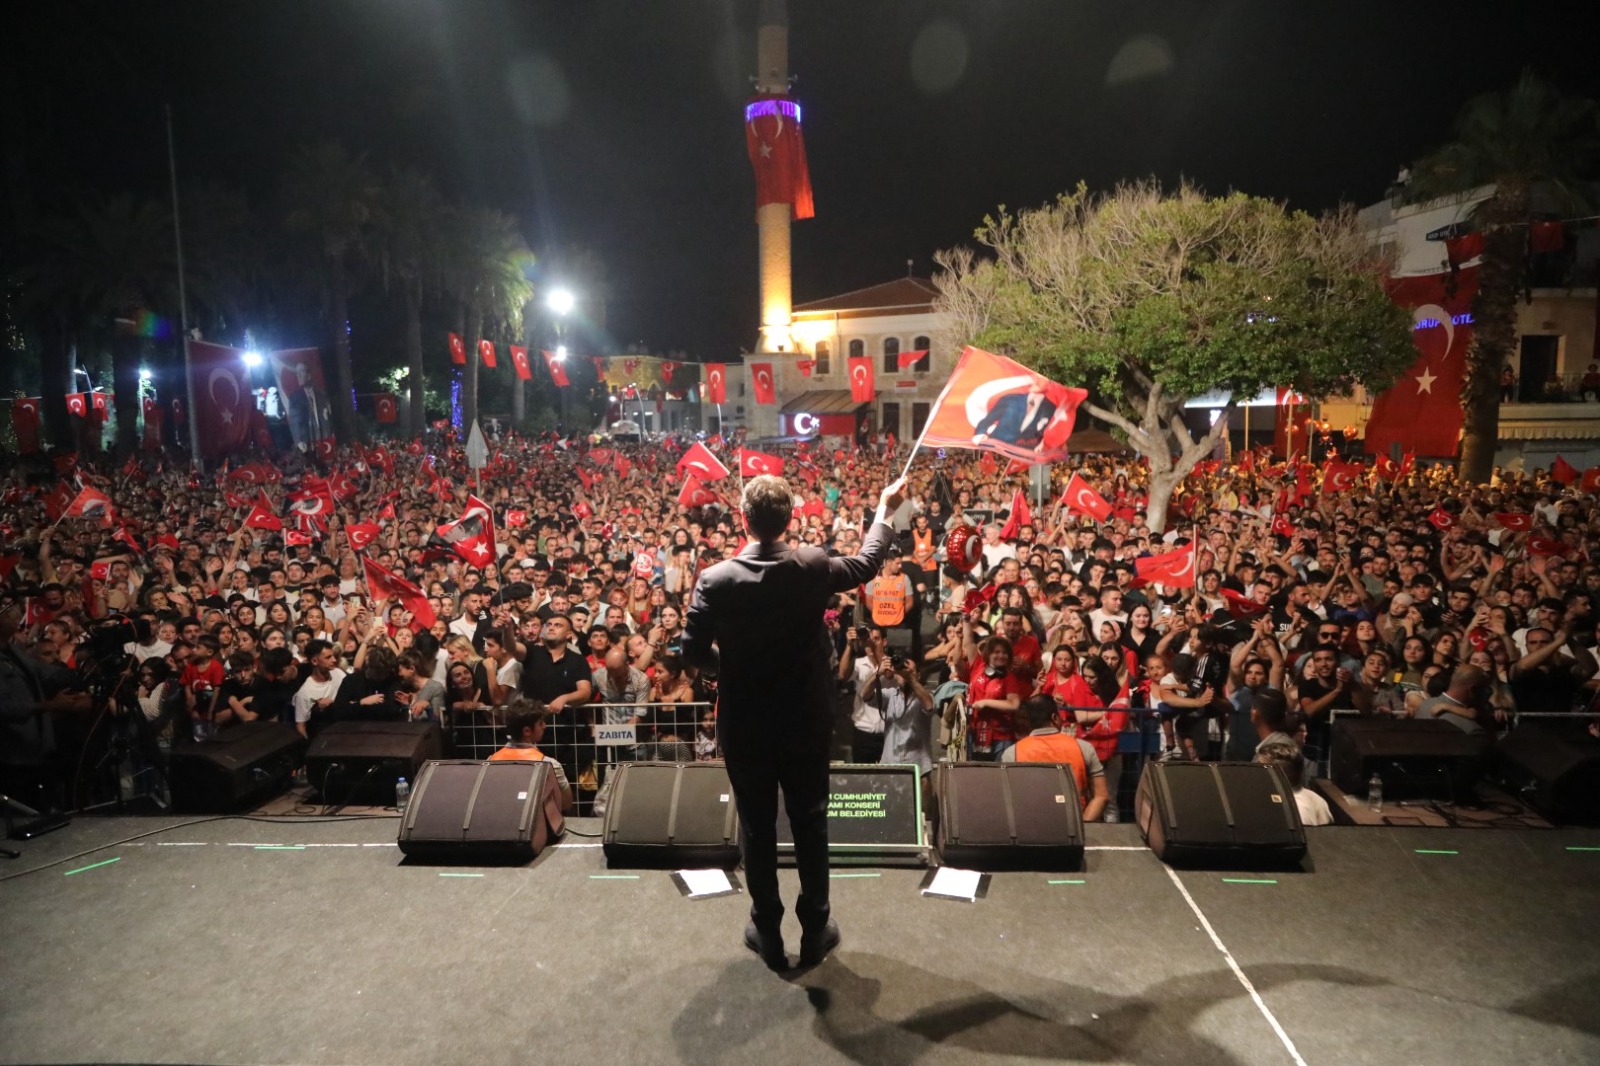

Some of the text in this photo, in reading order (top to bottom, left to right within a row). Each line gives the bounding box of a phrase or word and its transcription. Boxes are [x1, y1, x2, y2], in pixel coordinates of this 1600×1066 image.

[598, 730, 633, 740] ZABITA
[833, 792, 887, 801] CUMHURİYET
[844, 801, 881, 809] KONSERİ
[839, 809, 886, 818] BELEDİYESİ
